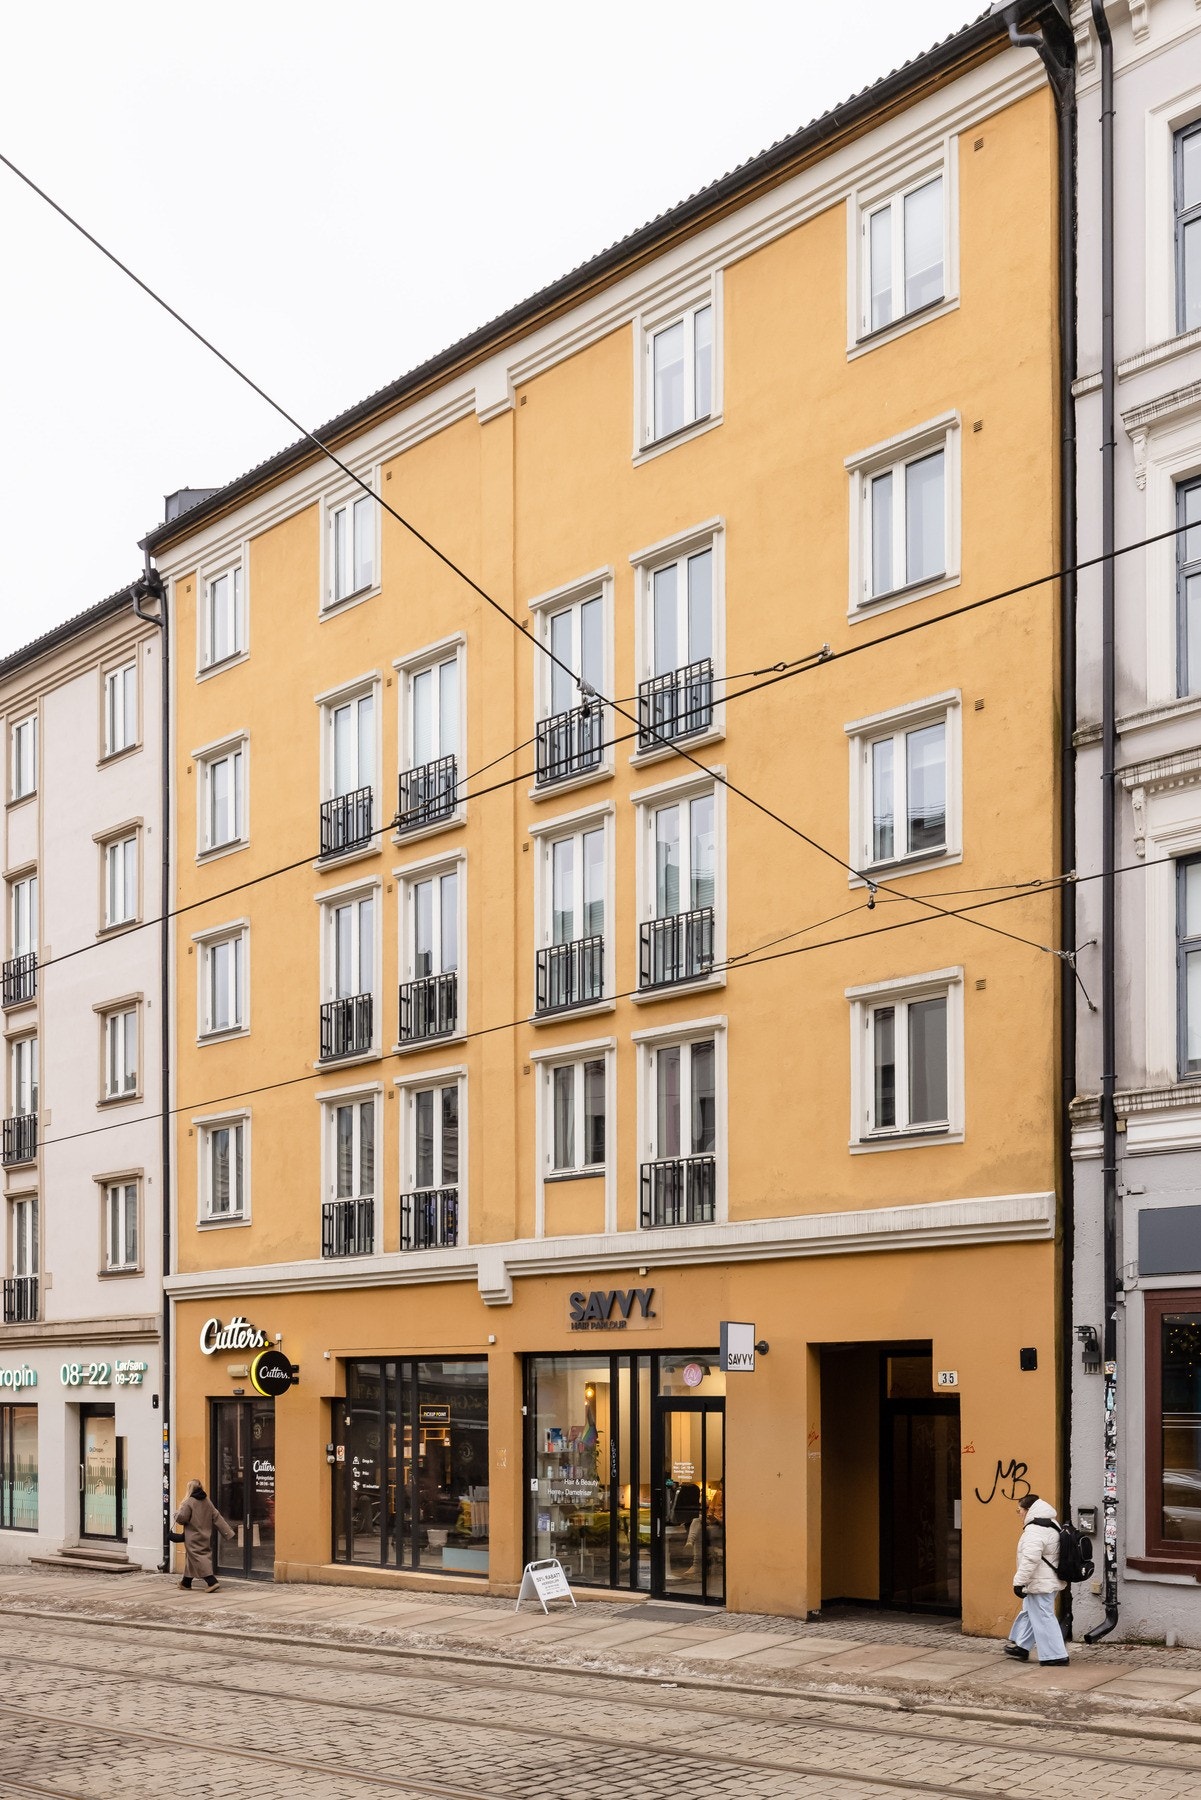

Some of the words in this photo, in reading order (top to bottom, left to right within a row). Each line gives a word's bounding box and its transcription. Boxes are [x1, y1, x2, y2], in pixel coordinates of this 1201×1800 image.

[569, 1287, 657, 1321] SAVVY.
[571, 1322, 590, 1330] HAIR
[591, 1320, 628, 1330] PARLOUR
[942, 1373, 955, 1384] 35
[580, 1479, 599, 1487] Beauty
